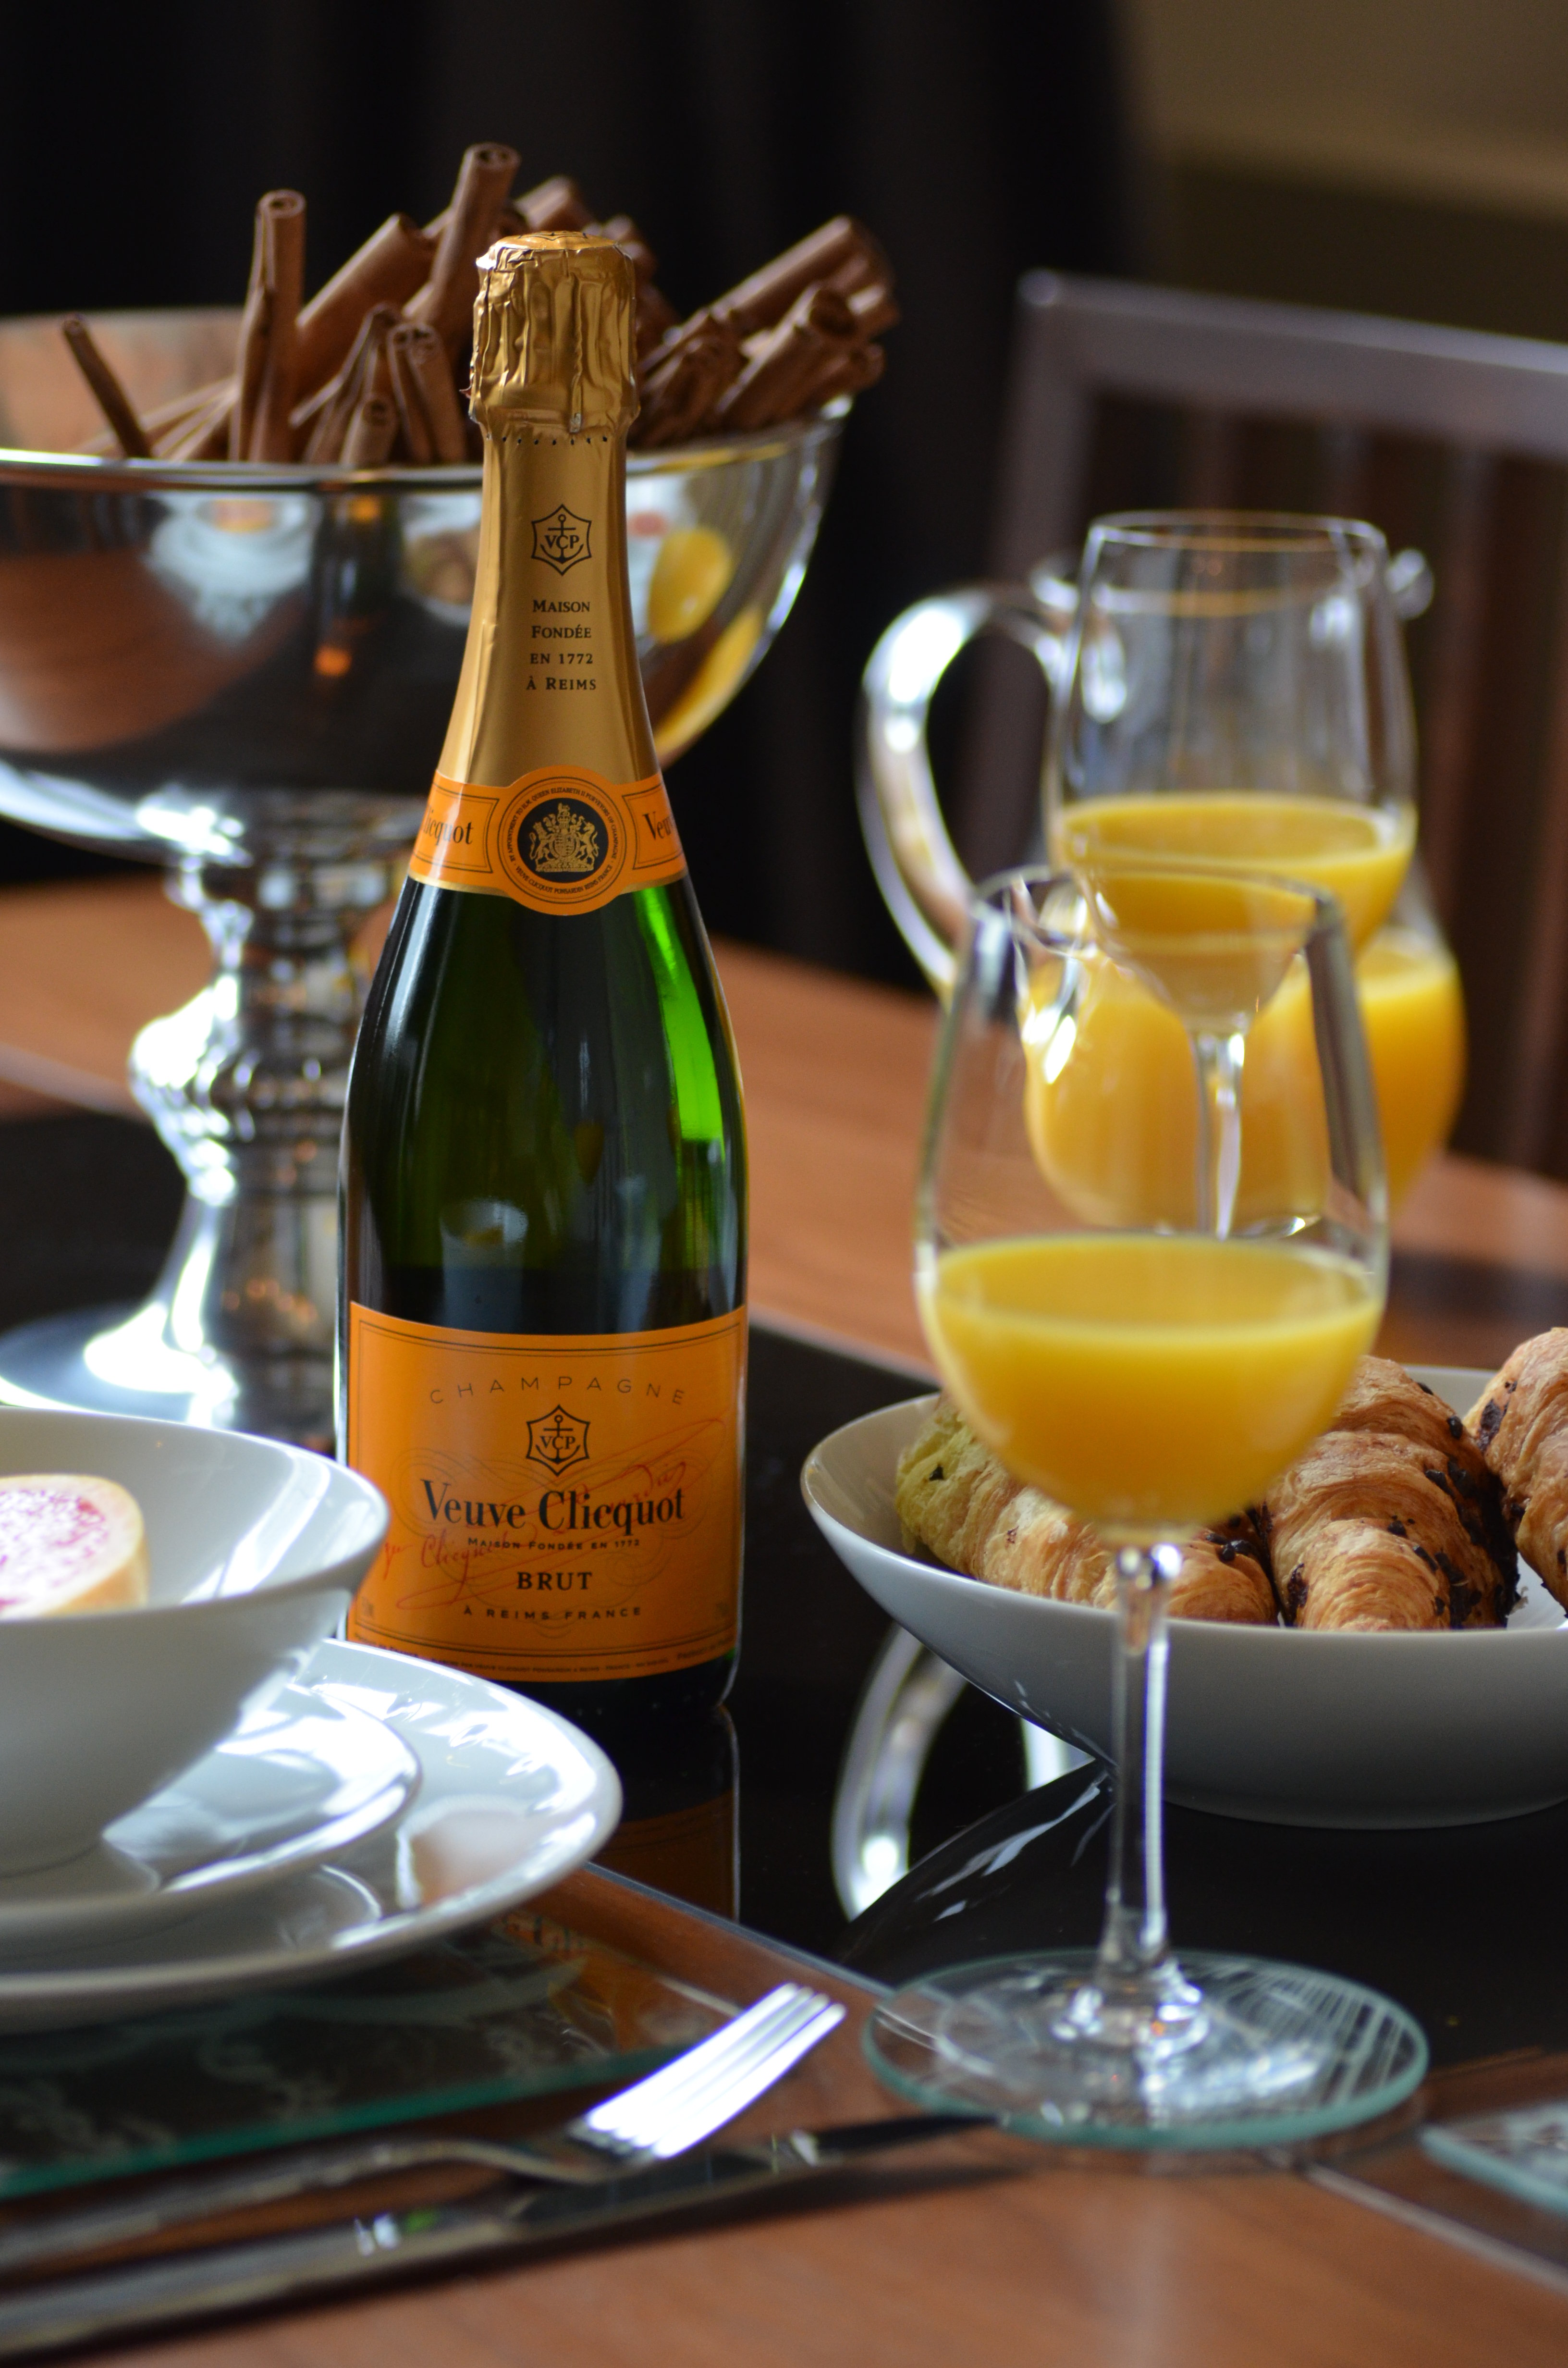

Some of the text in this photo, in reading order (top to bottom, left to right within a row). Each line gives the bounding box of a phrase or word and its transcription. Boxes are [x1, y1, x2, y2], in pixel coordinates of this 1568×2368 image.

[544, 534, 580, 549] VCP
[533, 600, 590, 613] MAISON
[531, 624, 592, 638] FONDÉE
[530, 653, 593, 665] EN 1772
[526, 676, 597, 691] À REIMS
[551, 787, 581, 796] ELIZABETH
[429, 1376, 685, 1405] CHAMPAGNE
[540, 1435, 576, 1450] VCP
[420, 1479, 526, 1529] Veuve
[539, 1488, 685, 1536] Clicquot
[467, 1538, 521, 1549] MAISON
[529, 1541, 583, 1550] FONDÉE
[615, 1539, 640, 1548] 1772
[516, 1571, 593, 1591] BRUT
[486, 1608, 551, 1620] REIMS
[564, 1606, 641, 1620] FRANCE
